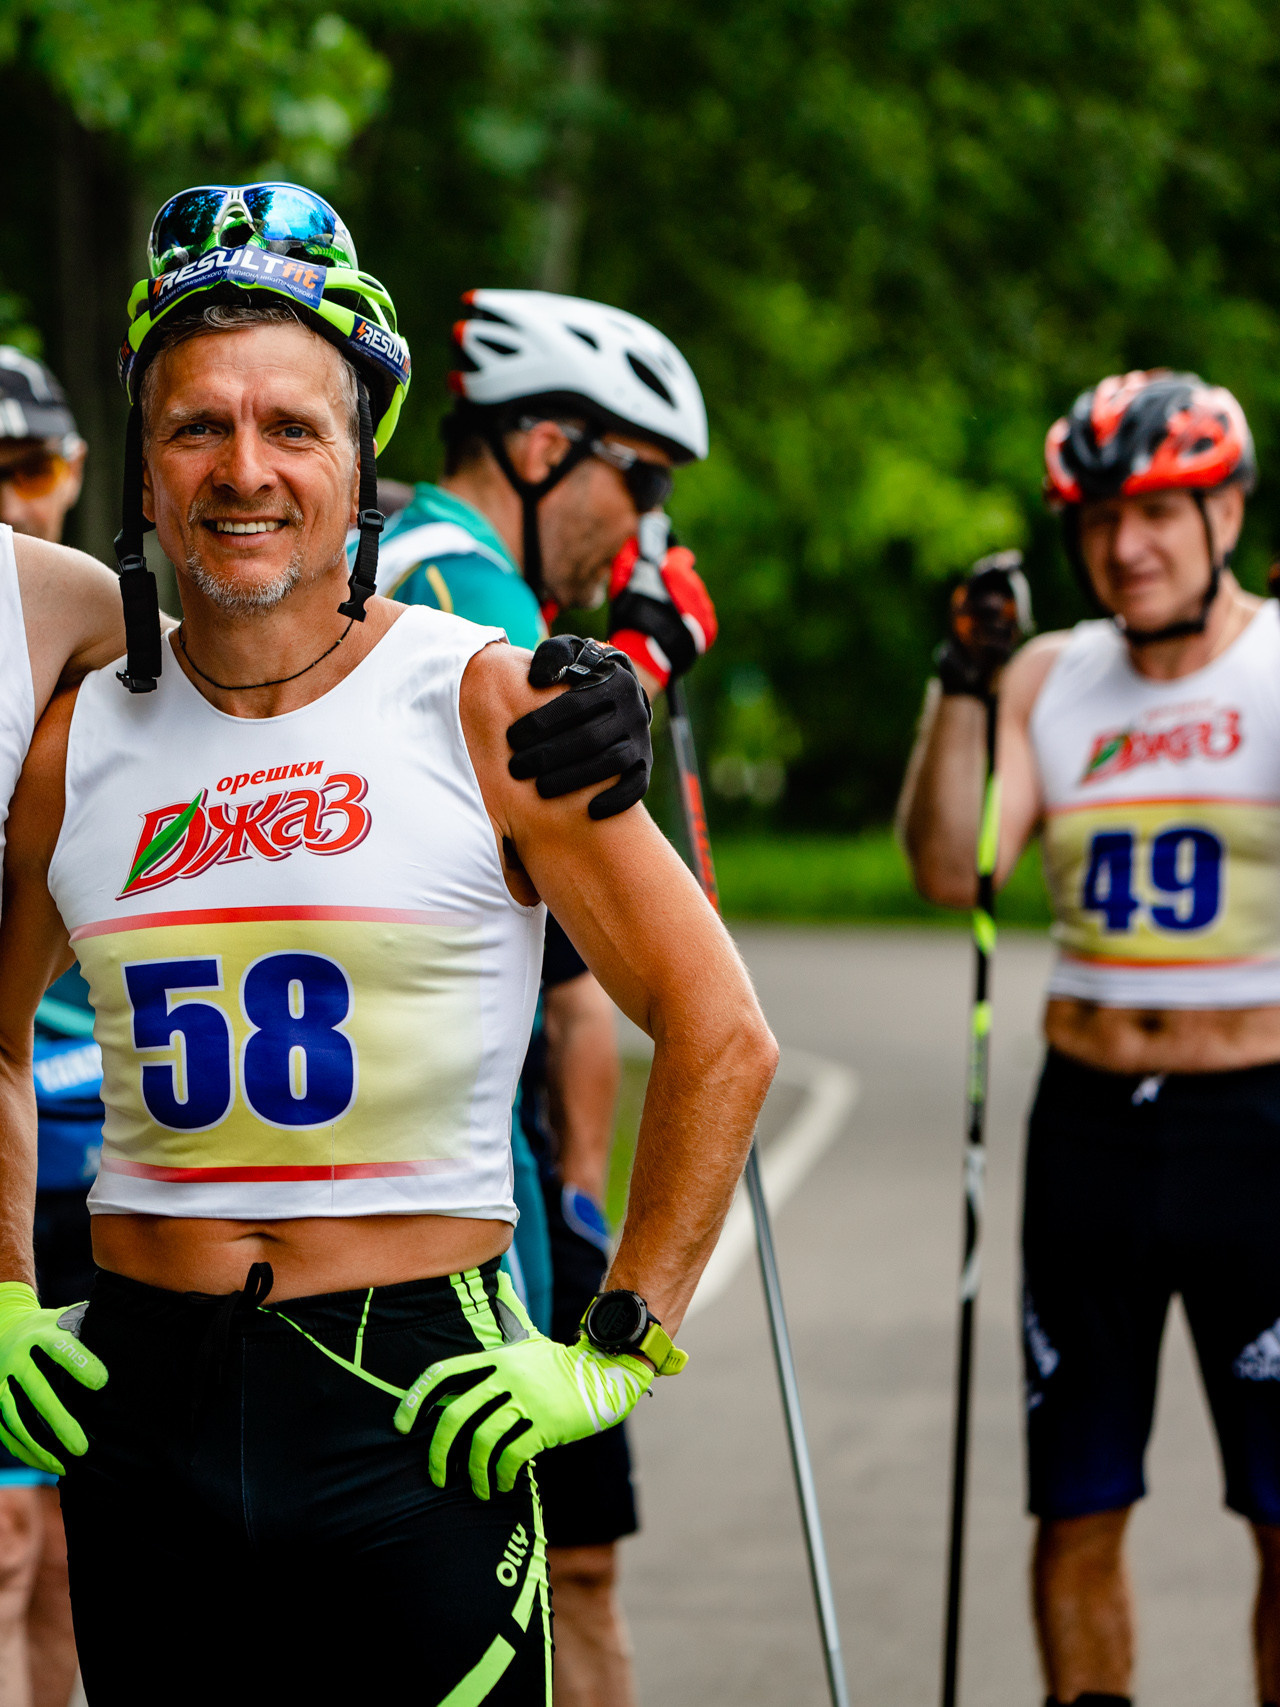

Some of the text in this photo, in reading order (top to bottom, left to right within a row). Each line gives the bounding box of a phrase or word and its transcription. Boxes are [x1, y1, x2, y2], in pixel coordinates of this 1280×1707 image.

[215, 759, 325, 796] орешки
[1082, 826, 1226, 934] 49
[123, 950, 358, 1132] 58
